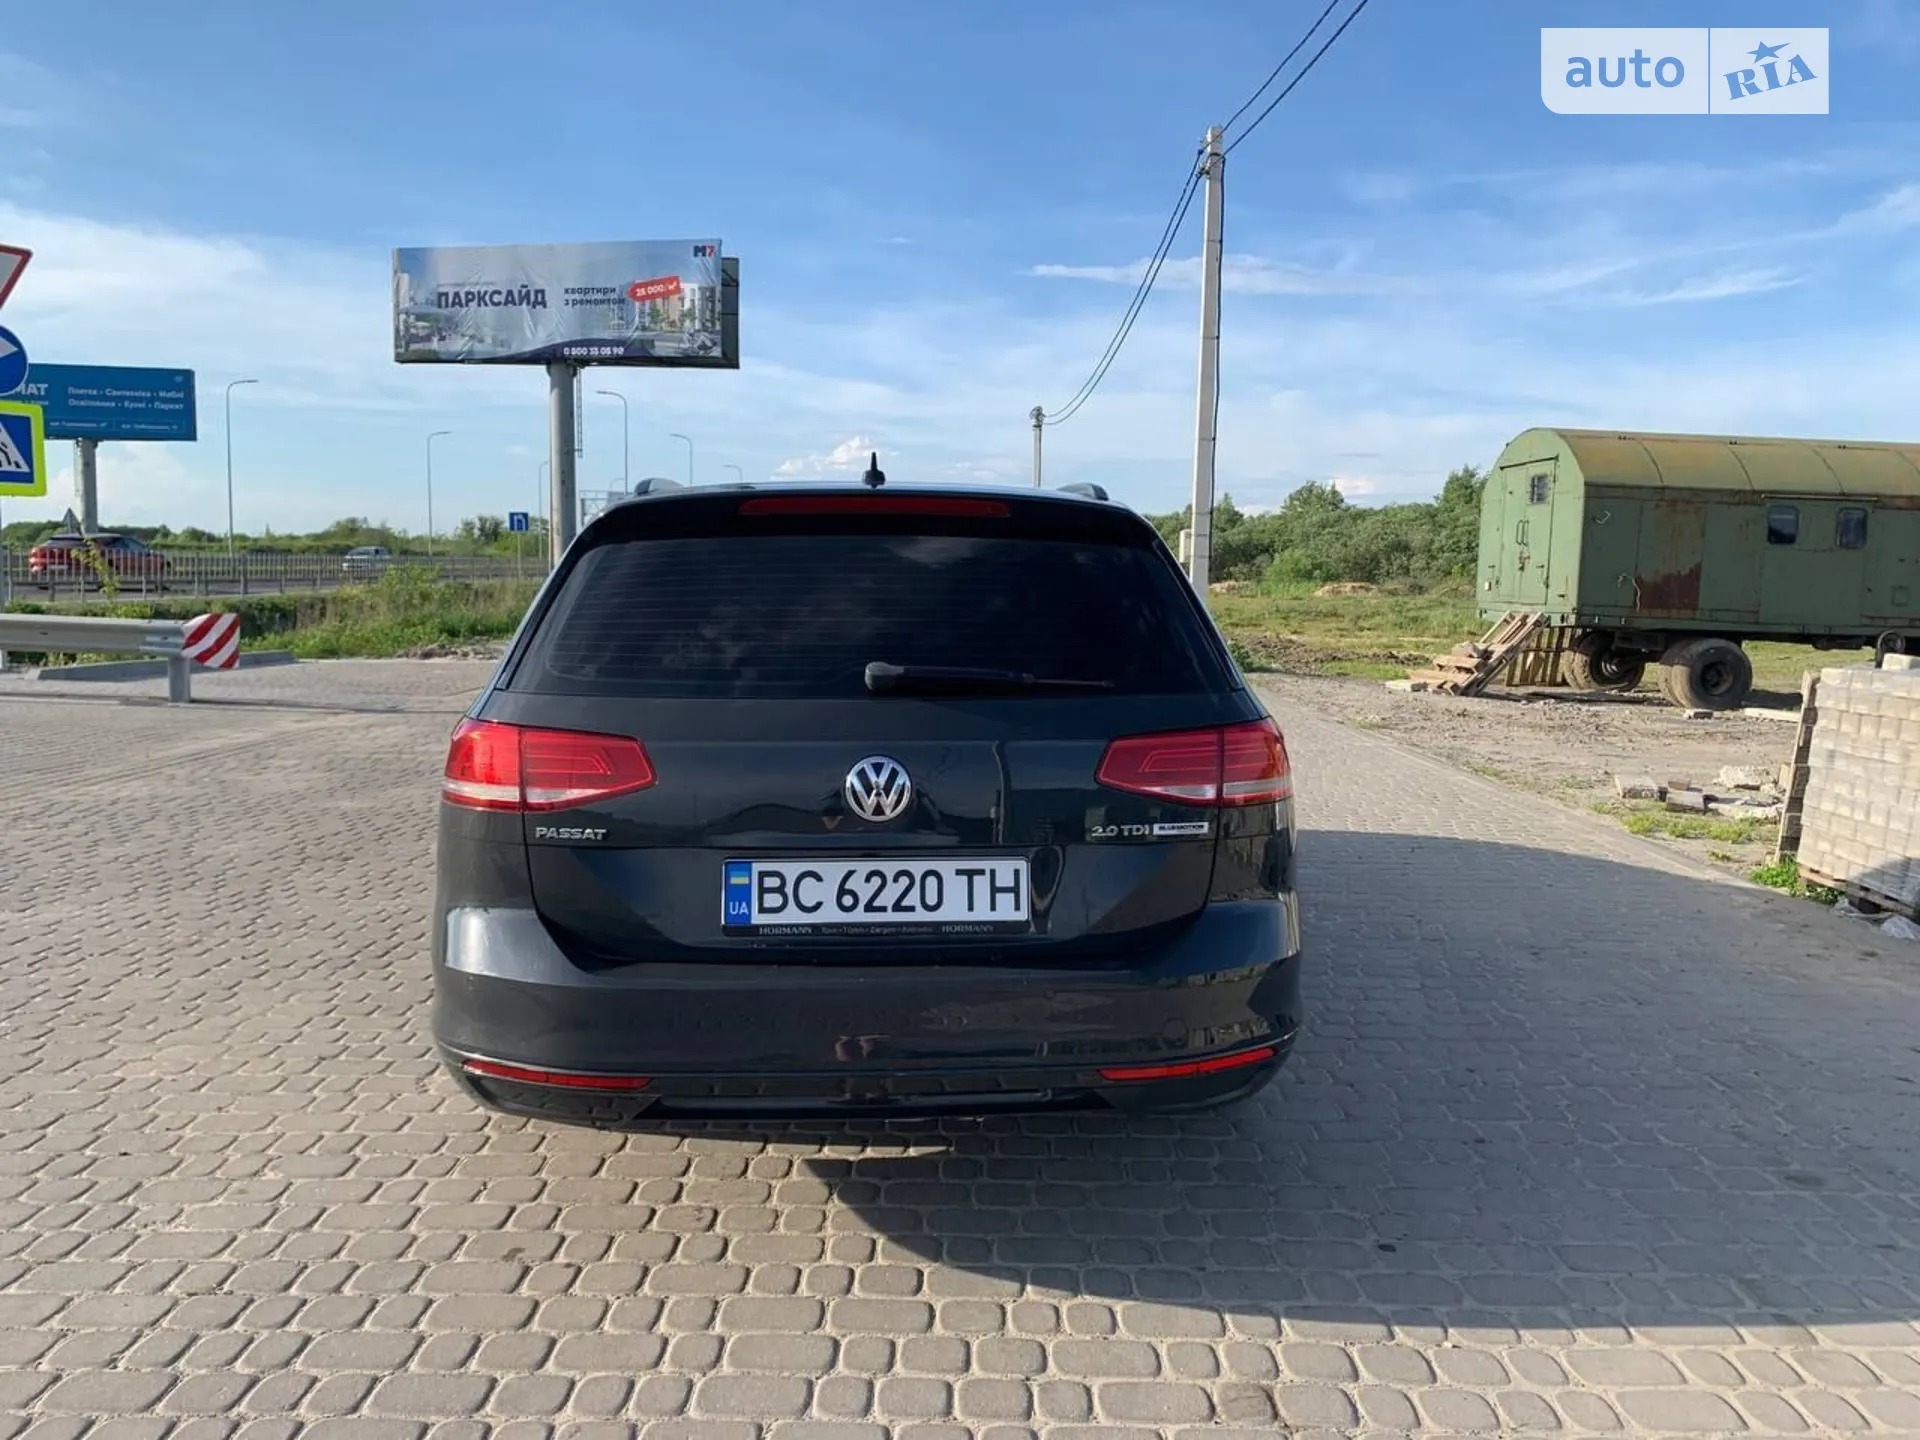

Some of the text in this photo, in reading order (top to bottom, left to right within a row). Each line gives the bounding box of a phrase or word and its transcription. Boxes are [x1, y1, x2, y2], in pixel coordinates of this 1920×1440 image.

[437, 284, 547, 309] ПАРКСАЙД
[564, 287, 616, 296] квартири
[571, 297, 626, 308] ремонтом
[535, 827, 607, 841] PASSAT
[1121, 824, 1150, 837] TDI
[757, 868, 1021, 914] BC 6220 TH
[729, 901, 749, 915] UA
